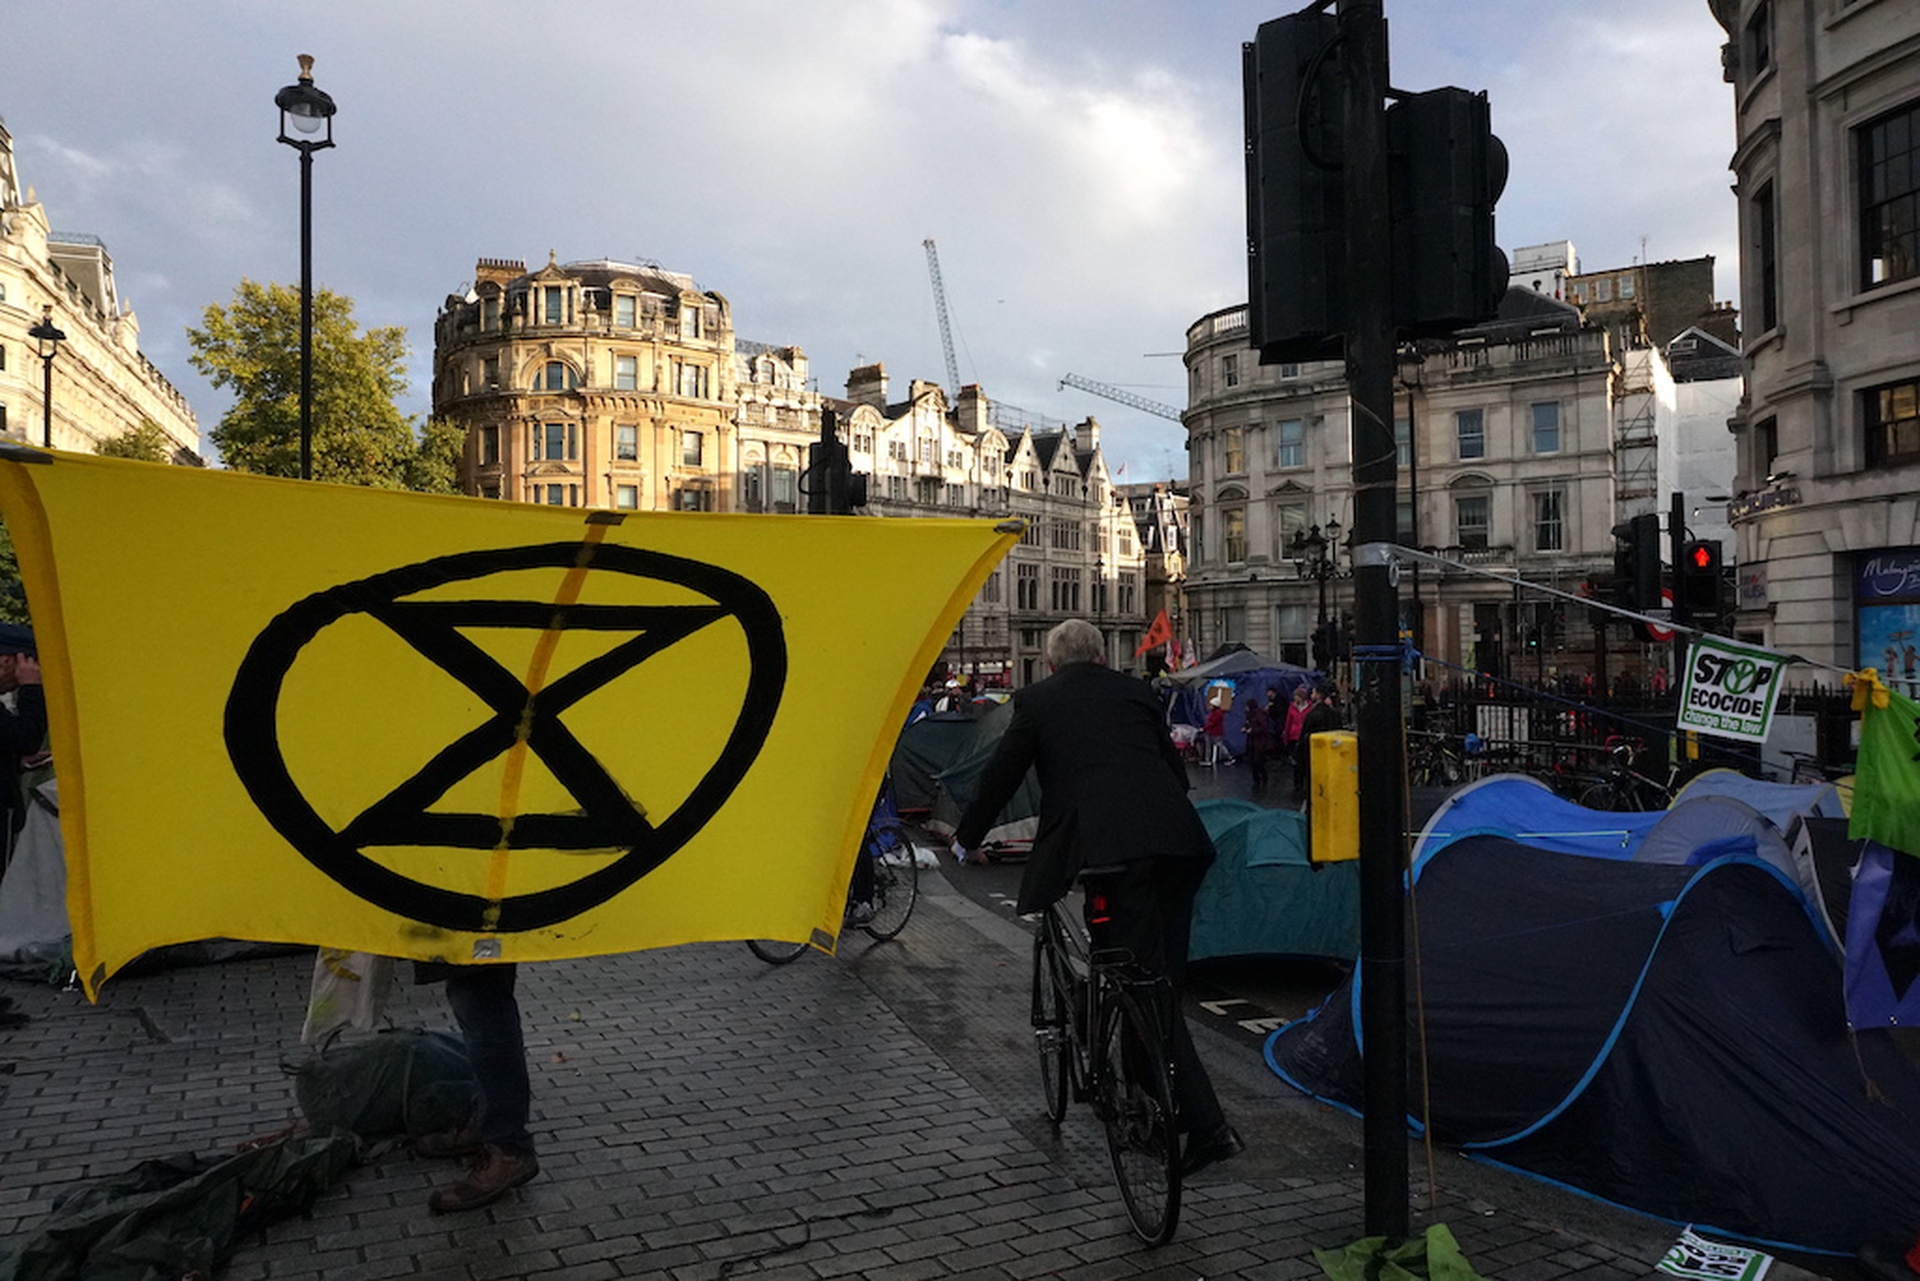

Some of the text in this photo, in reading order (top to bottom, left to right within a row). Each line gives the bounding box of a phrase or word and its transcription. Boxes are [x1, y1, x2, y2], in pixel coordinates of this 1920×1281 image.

[1863, 558, 1920, 595] Malaysi
[1694, 654, 1772, 695] STOP
[1690, 688, 1764, 717] ECOCIDE
[1684, 711, 1762, 734] change the law
